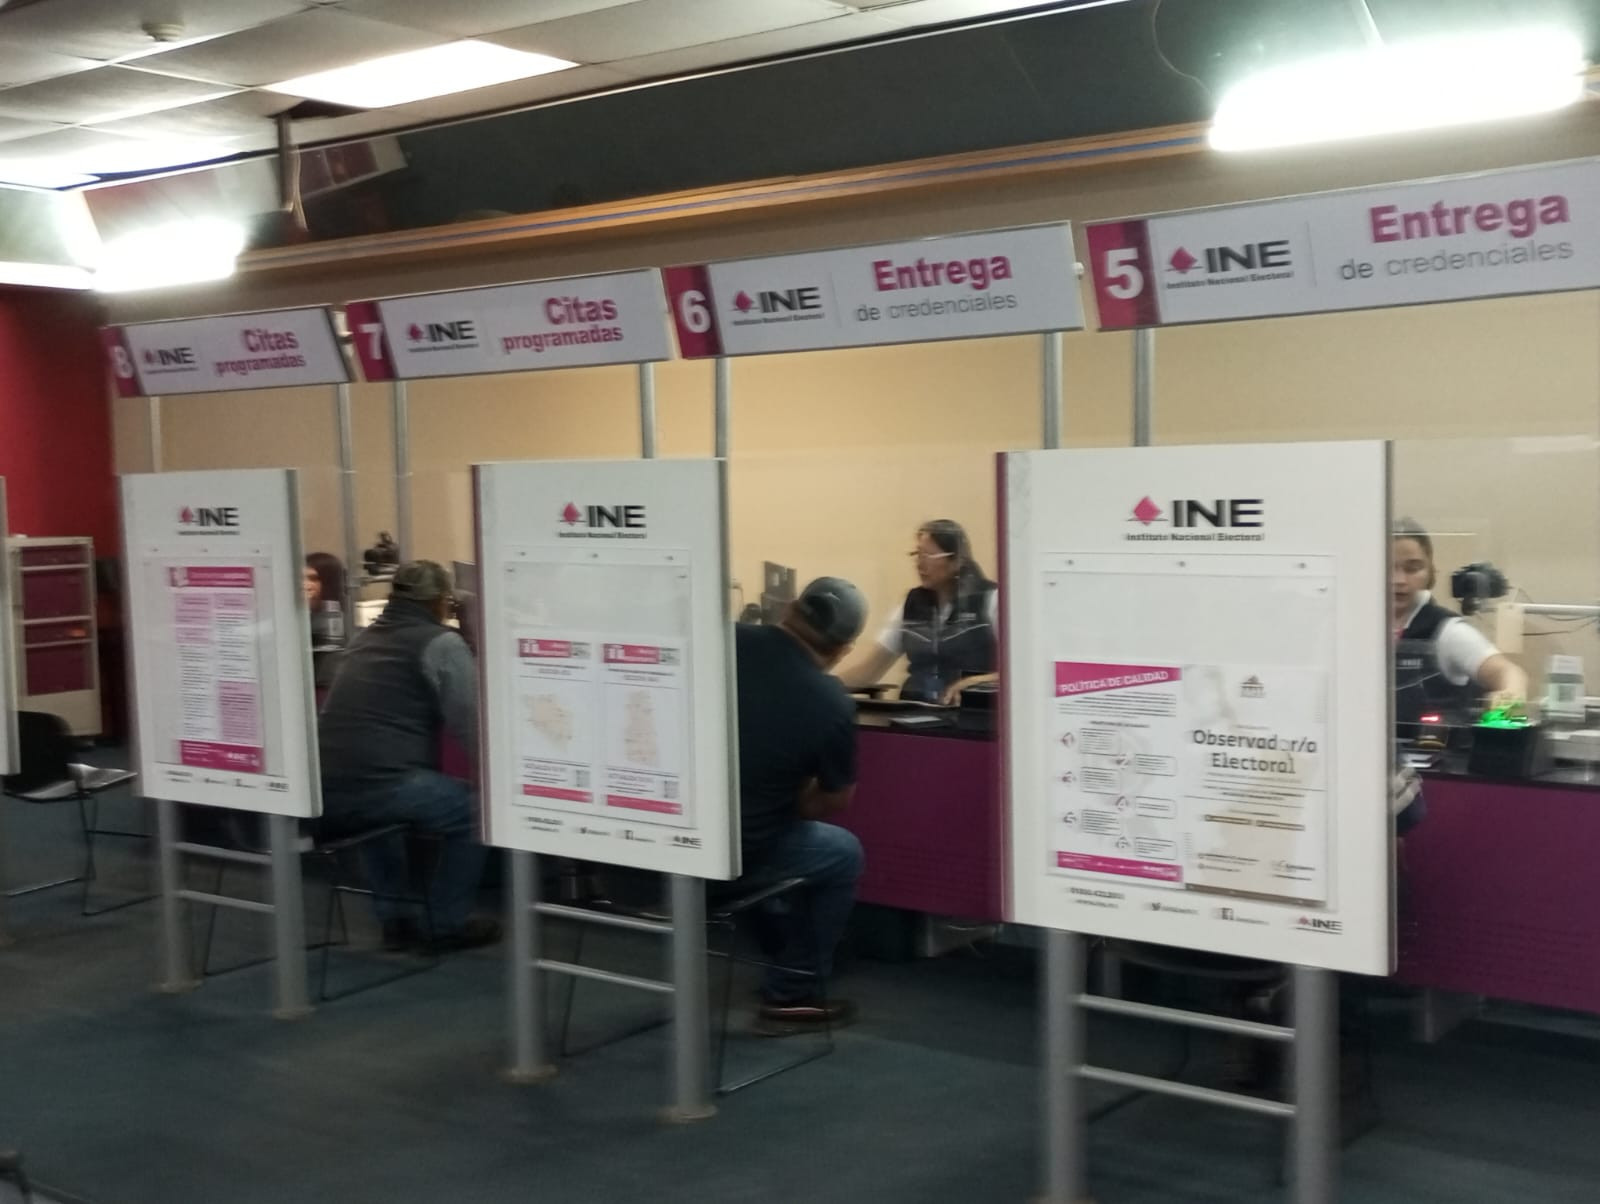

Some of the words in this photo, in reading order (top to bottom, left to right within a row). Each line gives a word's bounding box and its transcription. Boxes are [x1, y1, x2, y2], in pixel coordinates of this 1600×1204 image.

[1370, 194, 1569, 243] Entrega
[1205, 240, 1292, 274] INE
[1340, 257, 1374, 281] de
[1386, 238, 1575, 276] credenciales
[872, 255, 1013, 293] Entrega
[1103, 247, 1144, 300] 5
[544, 296, 619, 325] Citas
[680, 290, 711, 334] 6
[758, 286, 822, 313] INE
[855, 303, 881, 323] de
[889, 291, 1018, 320] credenciales
[242, 328, 299, 352] Citas
[359, 322, 383, 361] 7
[427, 320, 477, 342] INE
[502, 324, 624, 355] programadas
[112, 345, 134, 380] 8
[159, 347, 194, 366] INE
[215, 353, 306, 377] programadas
[197, 507, 240, 527] INE
[586, 504, 647, 528] INE
[1171, 498, 1264, 528] INE
[1125, 532, 1168, 542] Instituto
[1171, 532, 1215, 542] Nacional
[1217, 532, 1264, 542] Electoral
[1107, 677, 1122, 688] DE
[1122, 670, 1169, 686] CALIDAD
[1210, 752, 1297, 775] Electoral
[1311, 917, 1343, 931] INE
